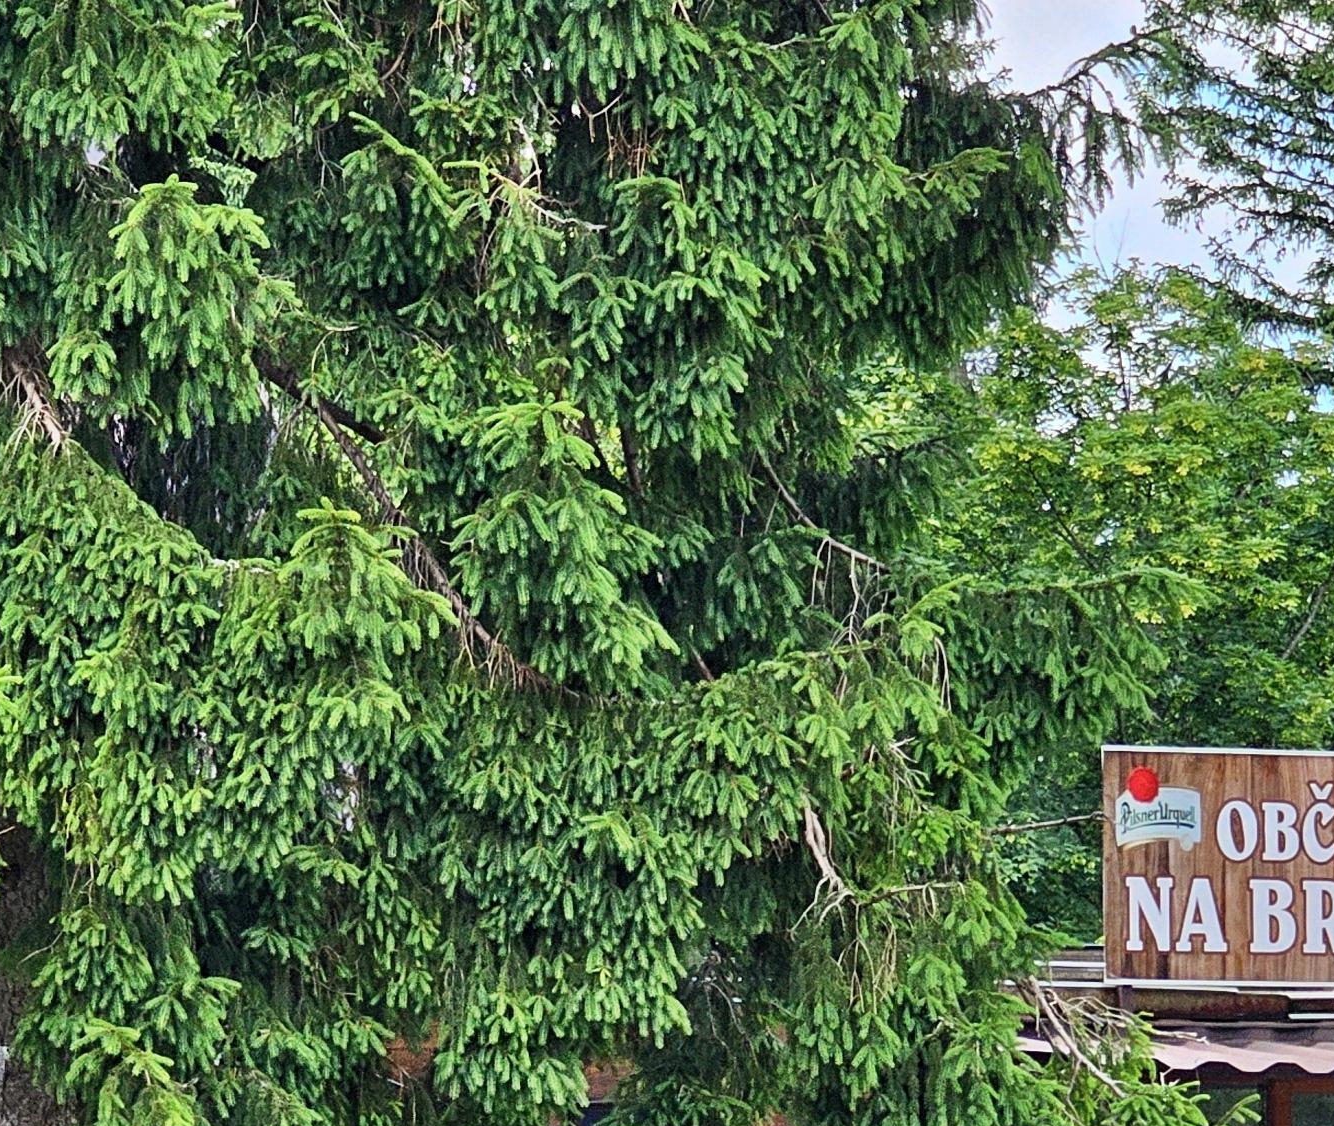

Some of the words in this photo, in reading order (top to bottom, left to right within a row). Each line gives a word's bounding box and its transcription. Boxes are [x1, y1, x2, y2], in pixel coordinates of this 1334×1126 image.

[1120, 801, 1160, 834] Pilsner
[1158, 801, 1196, 829] Urquell
[1125, 876, 1228, 952] NA
